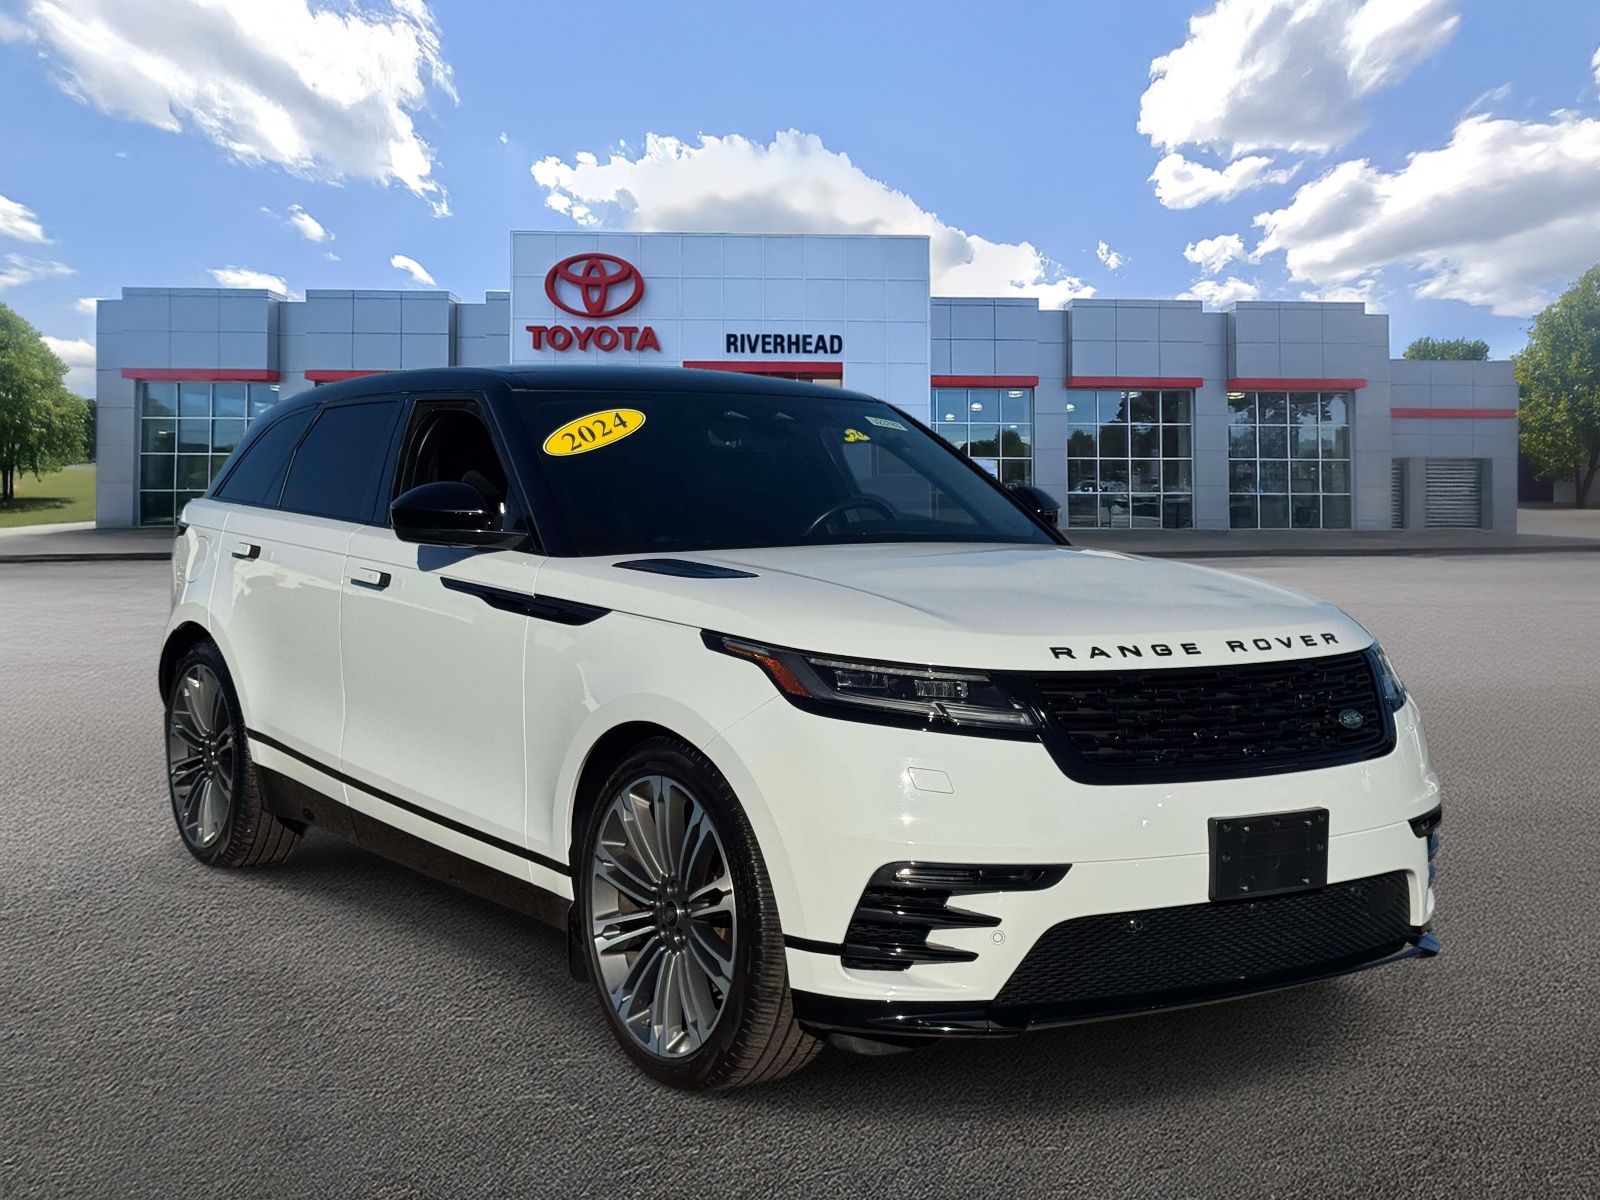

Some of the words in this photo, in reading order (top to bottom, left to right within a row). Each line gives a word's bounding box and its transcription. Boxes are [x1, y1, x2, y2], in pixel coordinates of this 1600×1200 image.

[526, 326, 661, 352] TOYOTA
[726, 333, 843, 354] RIVERHEAD
[561, 412, 628, 452] 2024
[1049, 642, 1202, 660] RANGE
[1226, 632, 1340, 653] ROVER
